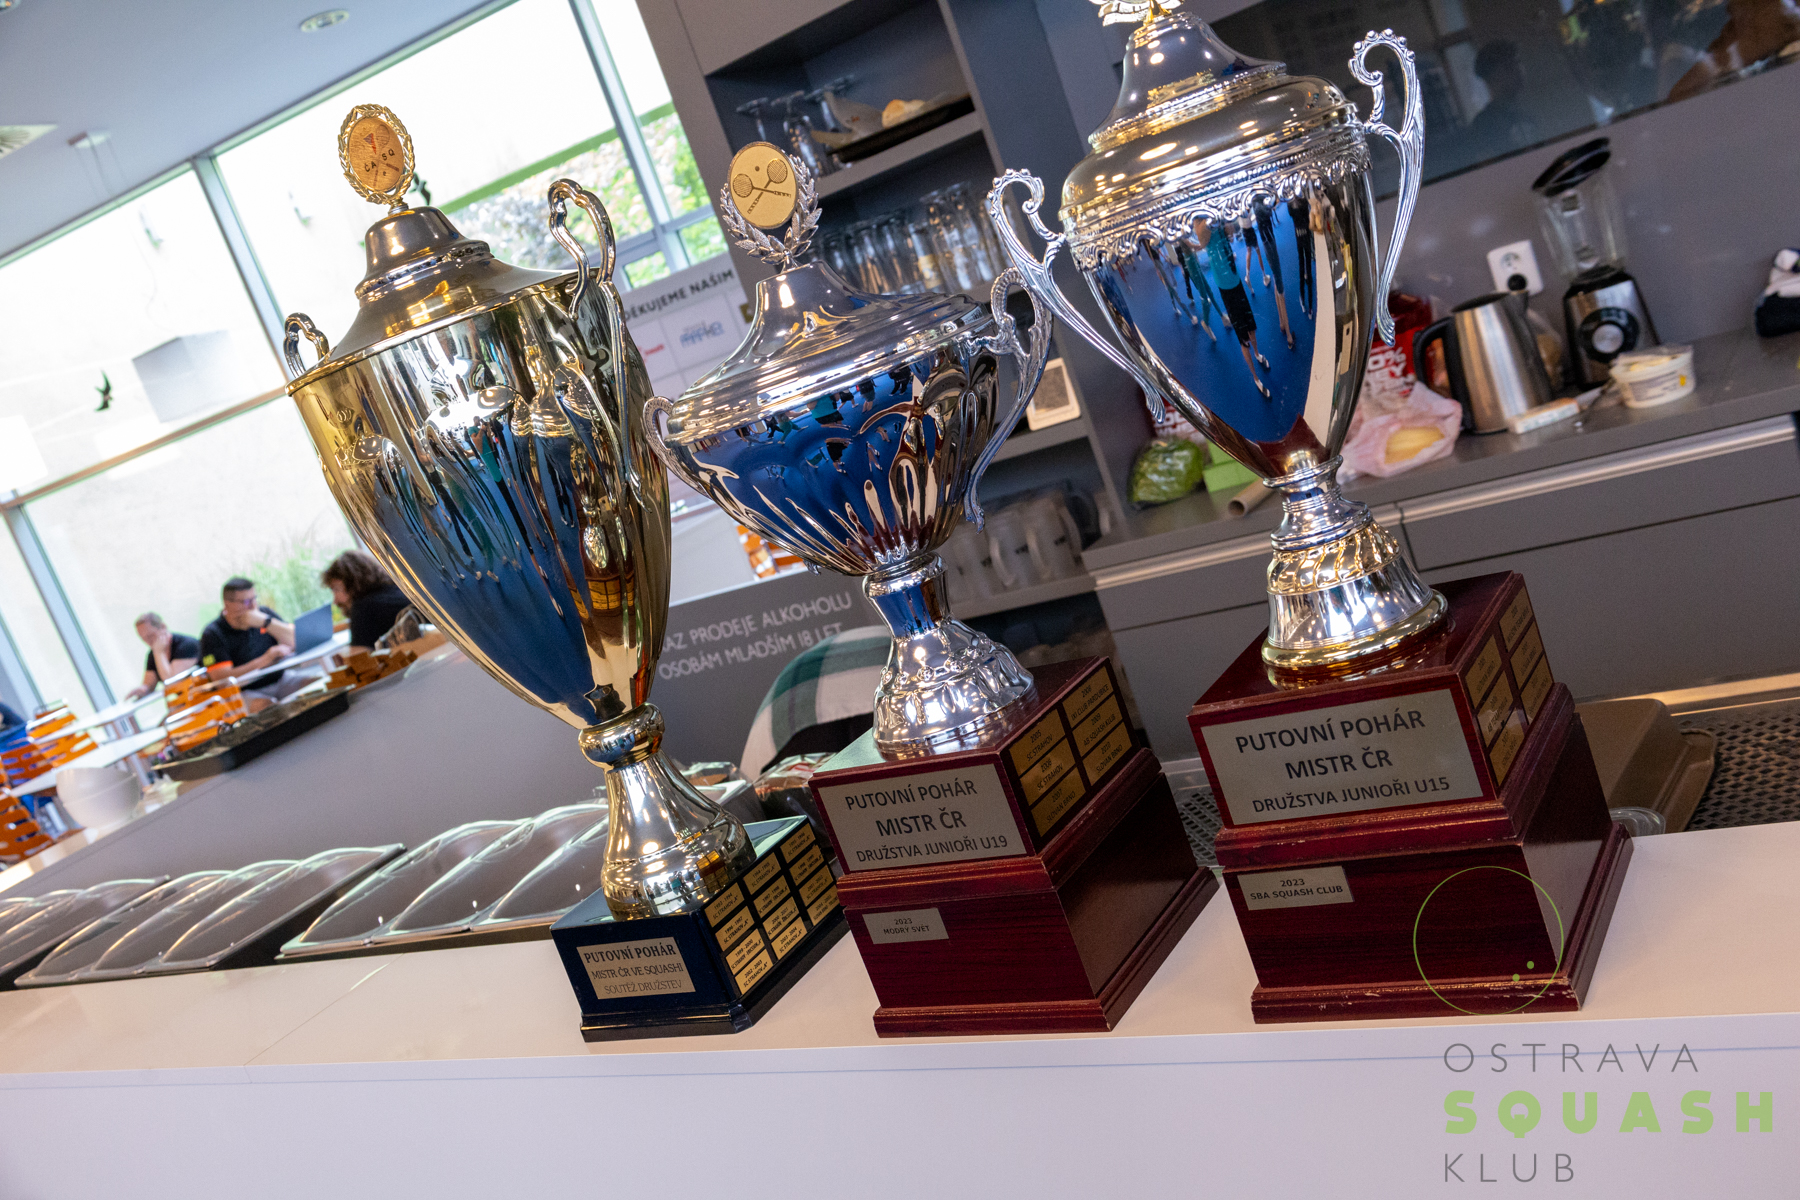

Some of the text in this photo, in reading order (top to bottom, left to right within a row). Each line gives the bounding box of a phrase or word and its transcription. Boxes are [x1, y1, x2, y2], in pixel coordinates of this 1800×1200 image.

[690, 614, 758, 646] PRODEJE
[762, 592, 852, 628] ALKOHOLU
[658, 651, 723, 680] OSOBÁM
[725, 632, 797, 664] MLADŠÍM
[798, 632, 814, 648] 18
[1030, 729, 1042, 743] 2005
[1089, 722, 1106, 742] SQUASH
[1235, 708, 1426, 754] PUTOVNÍ POHÁR
[1026, 734, 1054, 762] SC STRAHOV
[1096, 743, 1123, 774] SLOVAN BRNO
[1284, 746, 1393, 780] MISTR ČR
[1037, 762, 1064, 792] SC STRAHOV
[844, 778, 978, 810] PUTOVNÍ POHÁR
[1252, 777, 1450, 813] DRUŽSTVA JUNIOŘI U15
[1046, 790, 1076, 824] SLOVAN BRNO
[875, 807, 967, 837] MISTR ČR
[792, 838, 806, 853] STRAHOV
[856, 835, 1008, 862] DRUŽSTVA JUNIOŘI U19
[756, 868, 771, 884] STRAHOV
[1280, 878, 1306, 887] 2023
[1250, 886, 1344, 900] SBA SQUASH CLUB
[717, 899, 734, 916] STRAHOV
[728, 923, 744, 940] STRAHOV
[883, 925, 909, 934] MODRÝ
[783, 933, 798, 950] STRAHOV
[584, 942, 676, 964] PUTOVNÍ POHÁR
[591, 962, 684, 980] MISTR ČR VE SQUASHI
[747, 966, 764, 984] STRAHOV
[604, 979, 682, 994] SOUTĚŽ DRUŽSTEV
